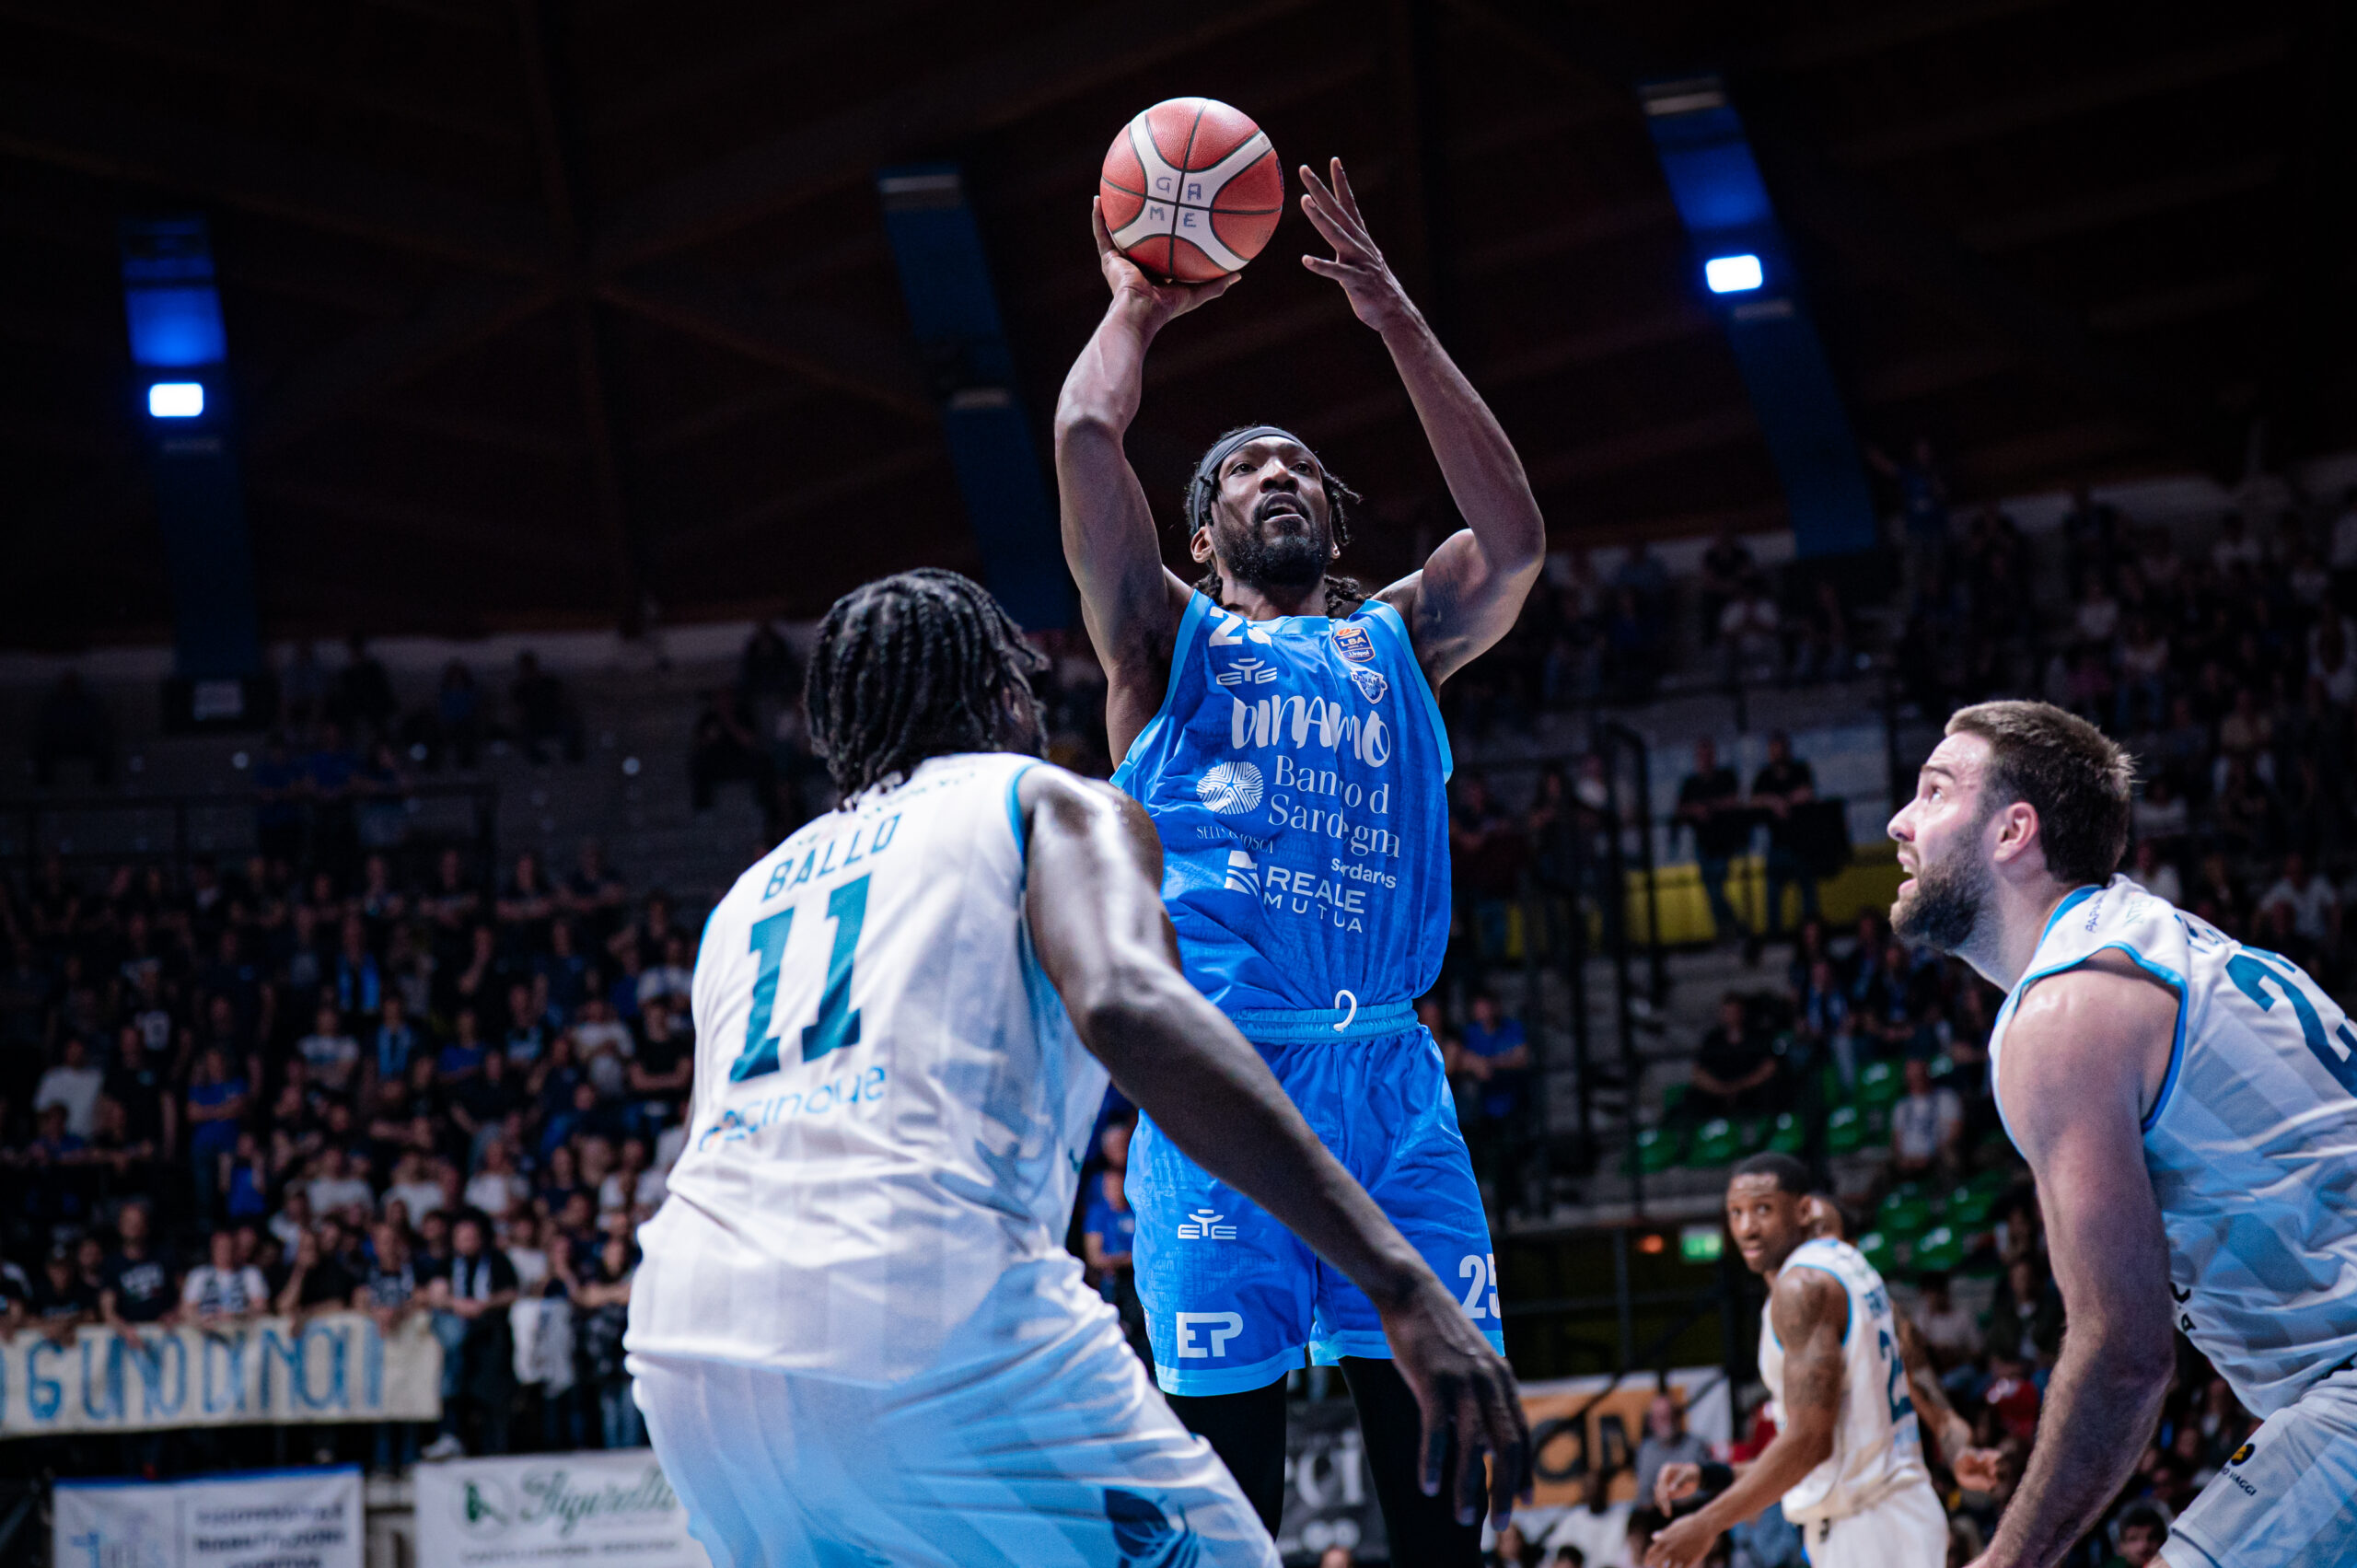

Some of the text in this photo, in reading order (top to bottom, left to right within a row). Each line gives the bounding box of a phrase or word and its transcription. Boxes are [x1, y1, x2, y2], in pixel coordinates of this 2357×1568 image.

[1340, 635, 1367, 647] LBA
[1232, 694, 1391, 768] DINAMO
[1369, 784, 1389, 814] d
[761, 812, 902, 903] BALLO
[1263, 891, 1363, 934] MUTUA
[1265, 865, 1366, 914] REALE
[731, 873, 872, 1083] 11
[1175, 1312, 1243, 1359] EP
